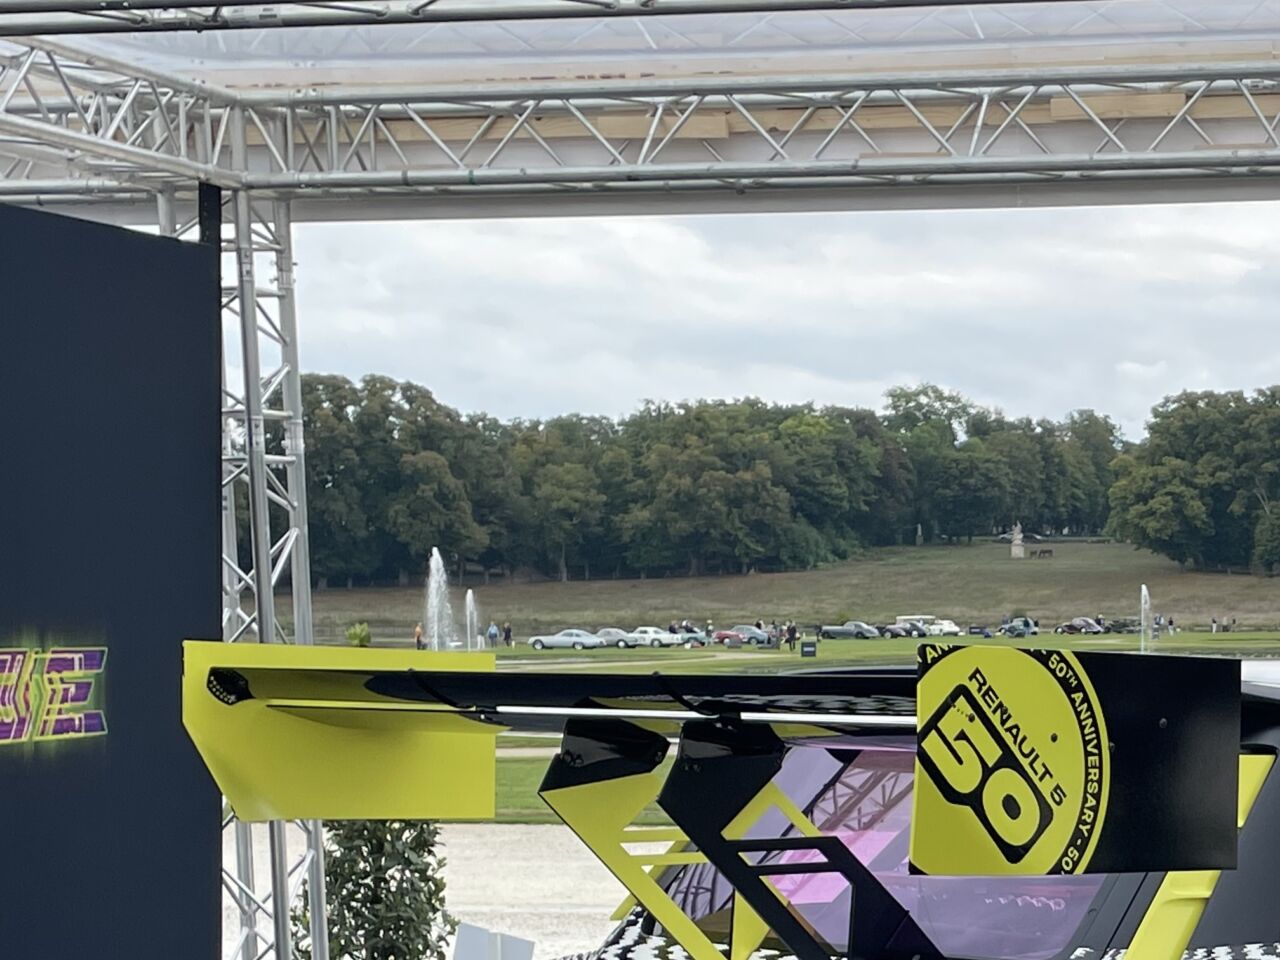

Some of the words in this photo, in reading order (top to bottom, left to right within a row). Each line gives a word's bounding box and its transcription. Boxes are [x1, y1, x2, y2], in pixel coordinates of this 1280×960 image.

[920, 694, 1041, 847] 50
[968, 667, 1053, 782] RENAULT
[1050, 783, 1067, 806] 5
[1048, 653, 1078, 687] 50TH
[1071, 692, 1100, 837] ANNIVERSARY
